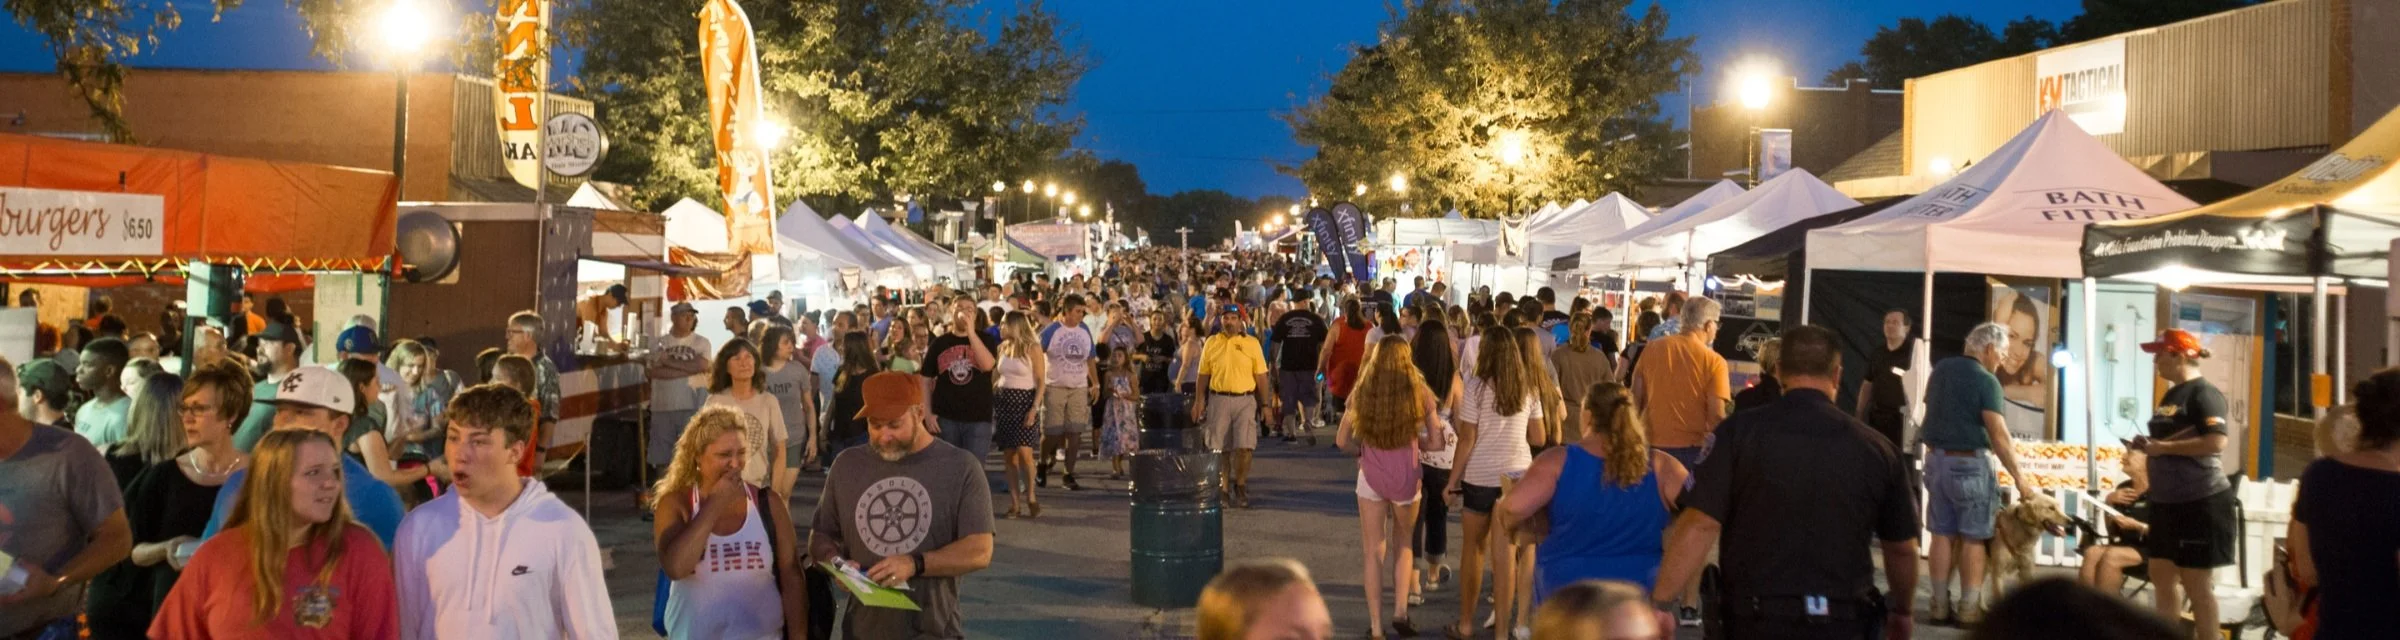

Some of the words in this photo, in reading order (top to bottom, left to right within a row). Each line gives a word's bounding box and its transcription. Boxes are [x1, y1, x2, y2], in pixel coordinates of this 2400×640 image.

[2042, 208, 2151, 221] FITTE
[2045, 190, 2145, 211] BATH
[1312, 213, 1339, 255] xfinity
[859, 479, 930, 509] GASOLINE
[702, 541, 765, 573] INK
